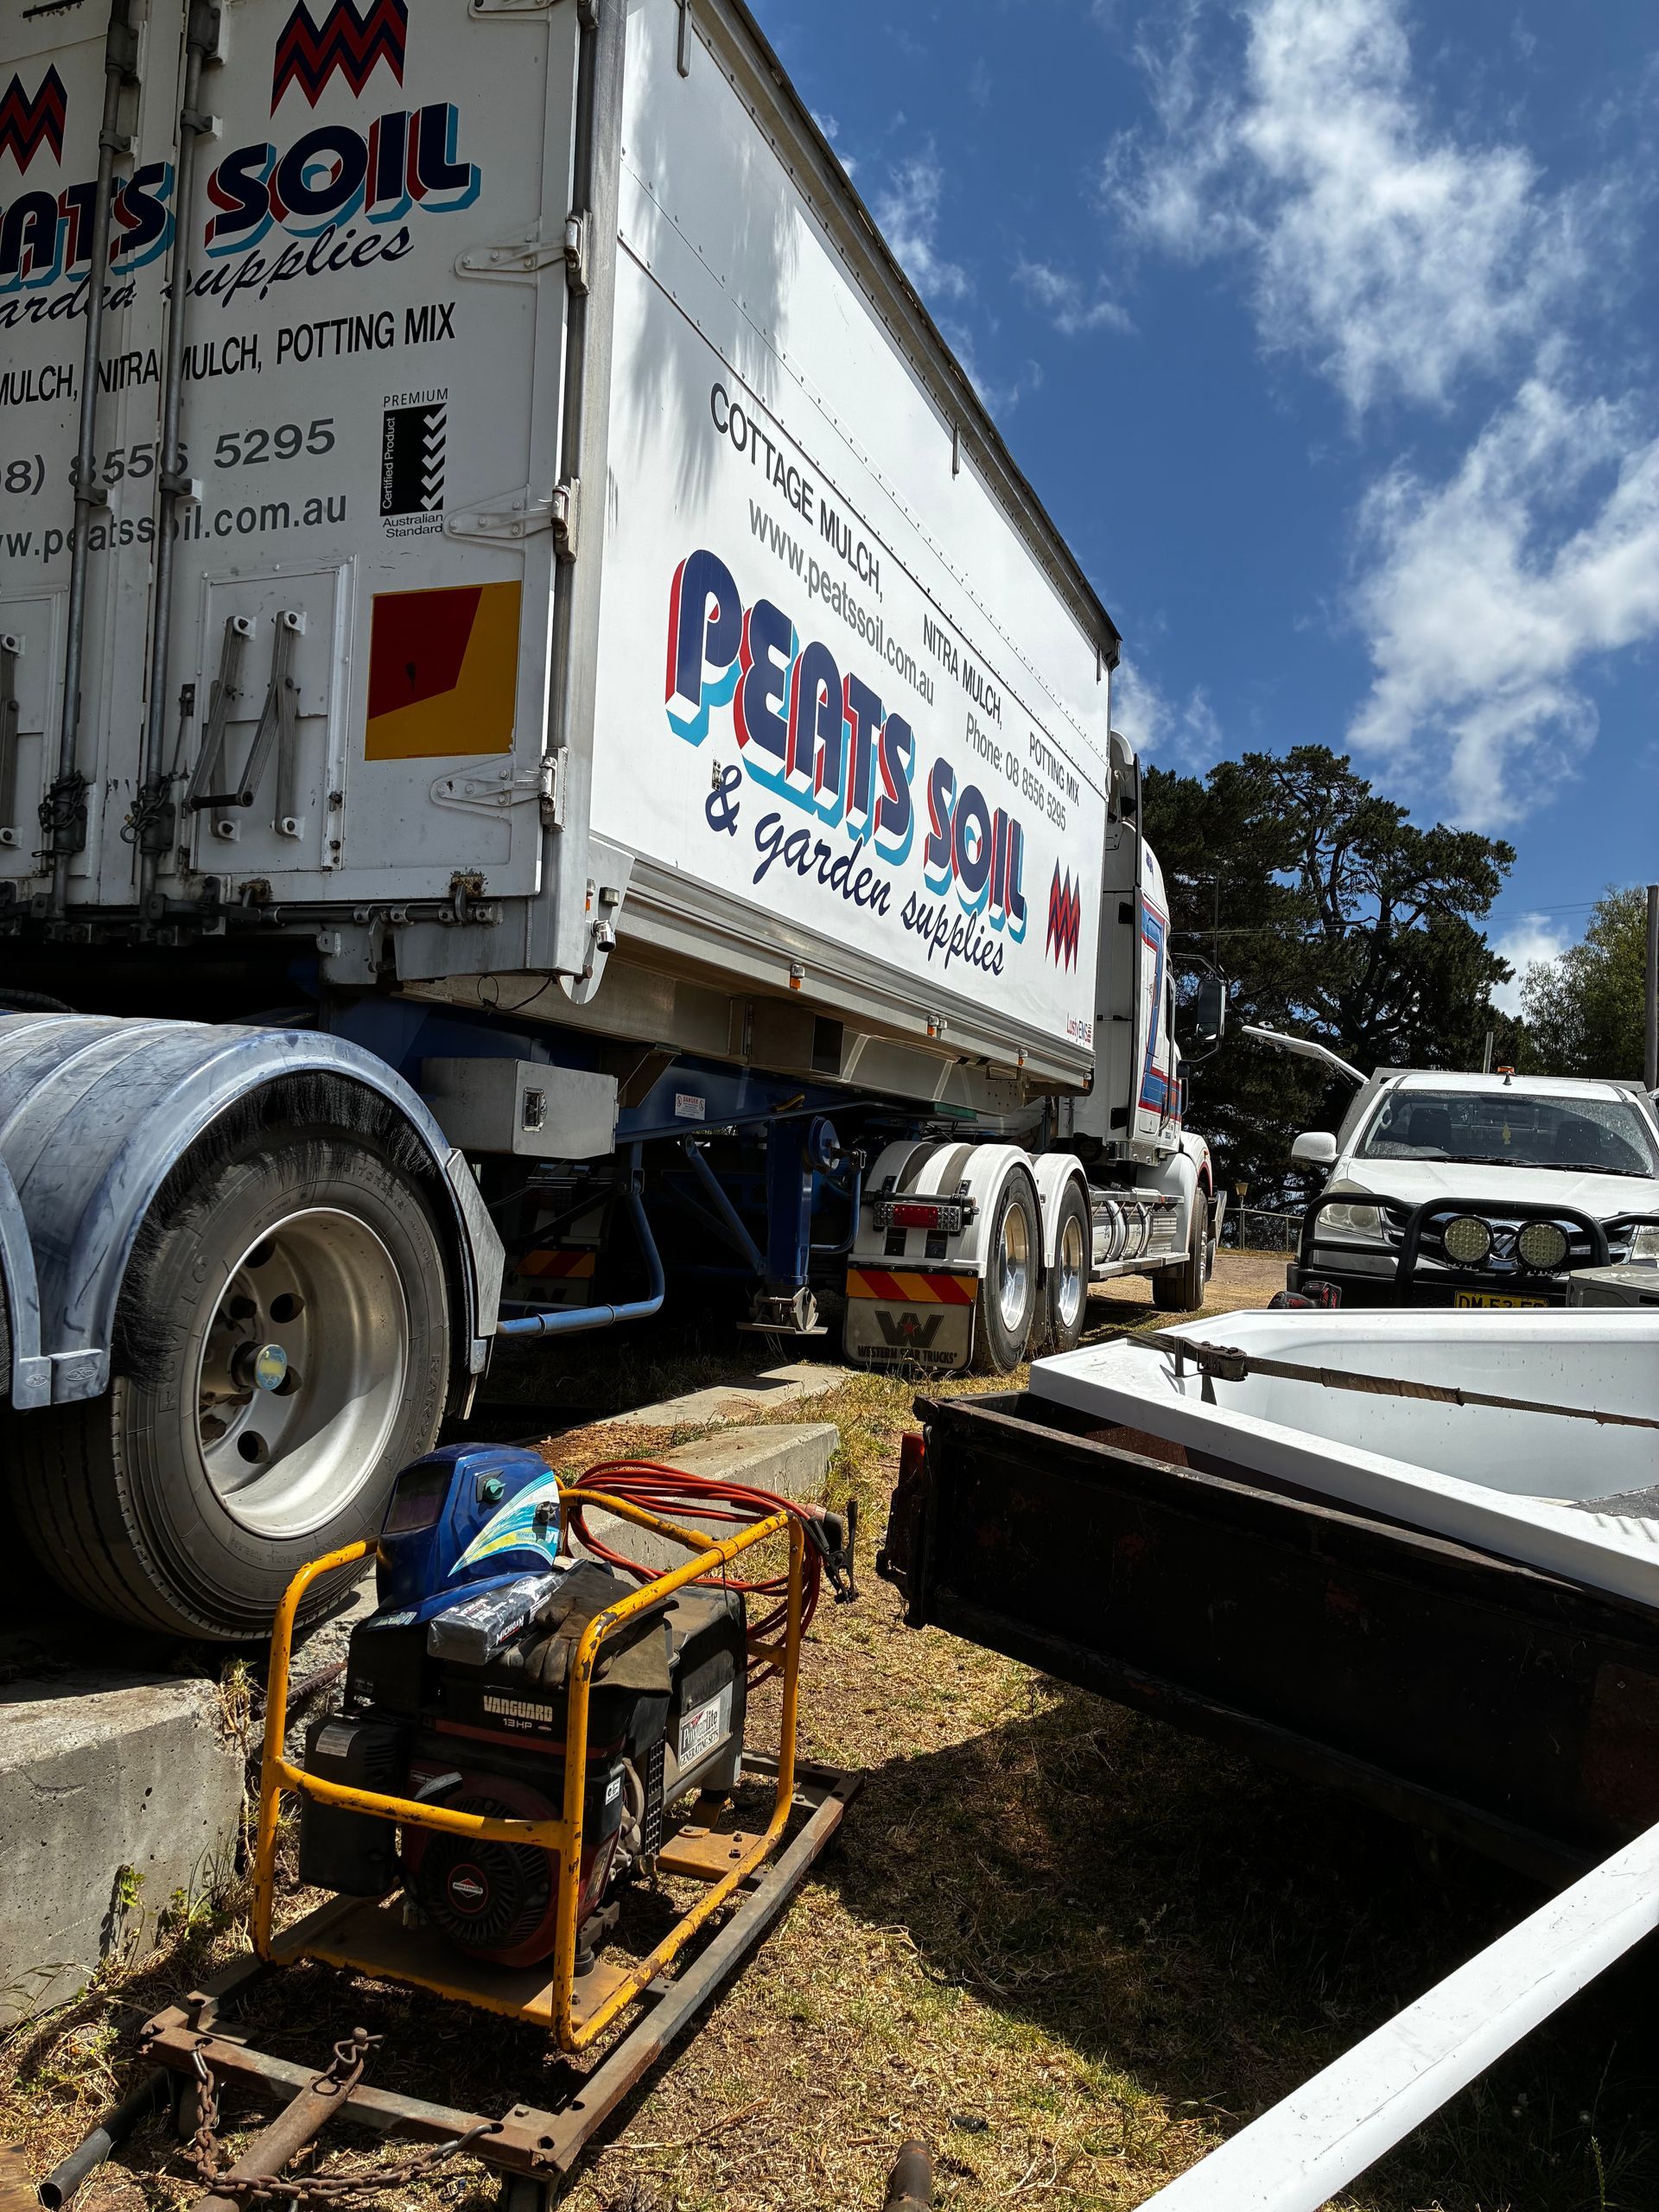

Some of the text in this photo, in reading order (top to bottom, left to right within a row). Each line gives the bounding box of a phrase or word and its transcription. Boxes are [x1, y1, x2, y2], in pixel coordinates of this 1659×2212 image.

[204, 102, 481, 258] SOIL
[276, 310, 395, 365] POTTING
[404, 302, 456, 346] MIX
[383, 388, 448, 408] PREMIUM
[213, 417, 335, 468] 5295
[382, 416, 396, 510] Certified Product
[382, 513, 443, 528] Australian
[385, 523, 443, 538] Standard
[710, 382, 1079, 806] COTTAGE MULCH, NITRA MULCH, POTTING MIX
[748, 498, 934, 707] www.peatssoil.com.au
[664, 549, 1027, 944] PEATS SOIL
[965, 711, 1066, 832] Phone: 08 8556 5295
[705, 764, 1006, 976] & garden supplies
[857, 1344, 898, 1359] WESTERN
[483, 1694, 553, 1722] VANGUARD
